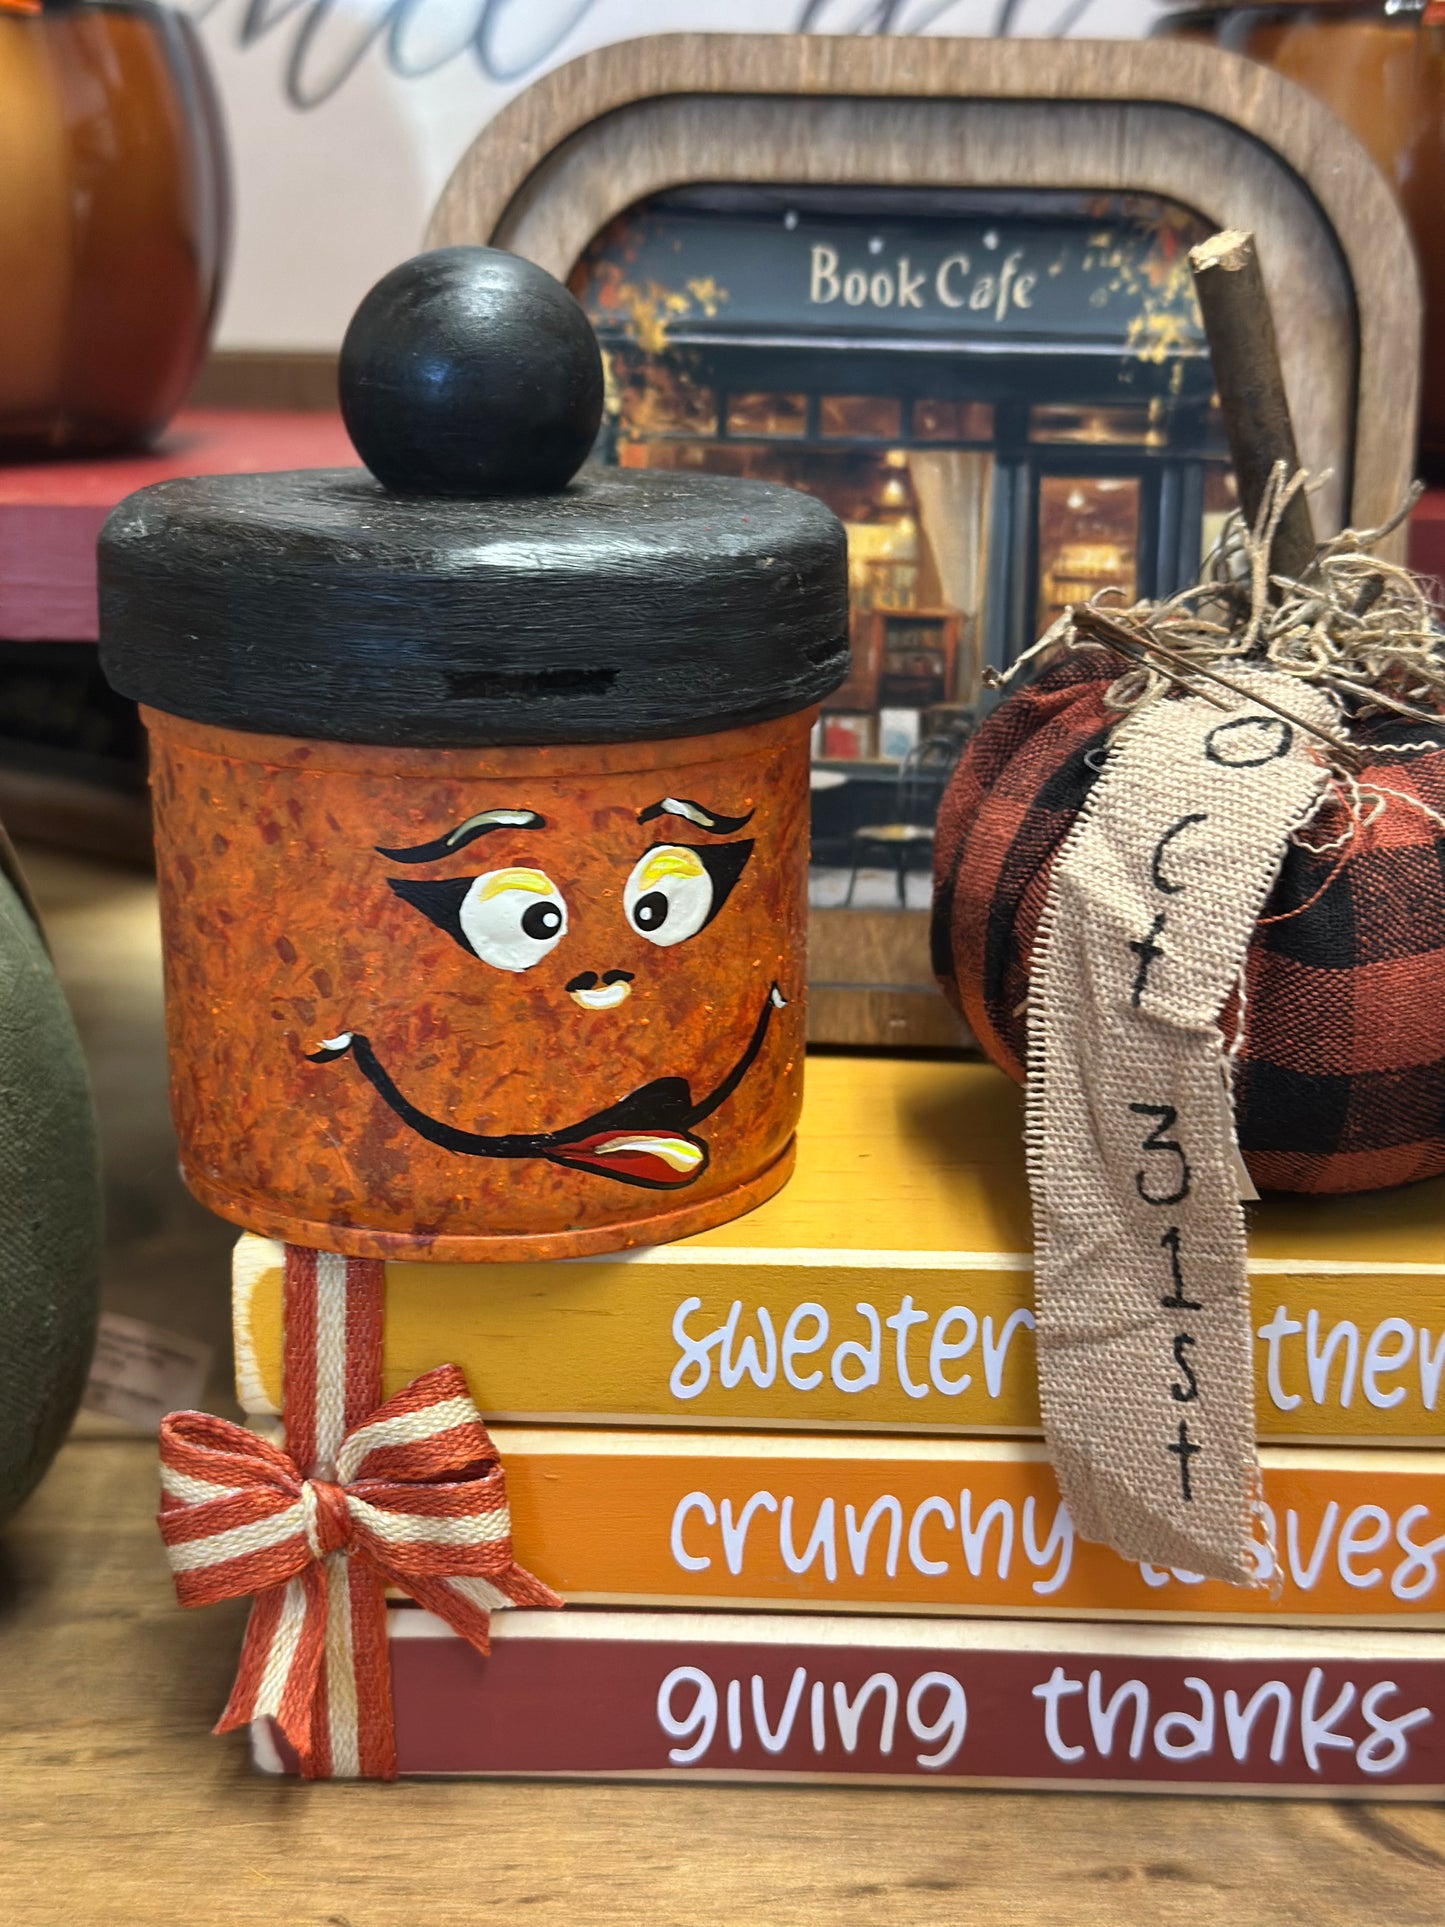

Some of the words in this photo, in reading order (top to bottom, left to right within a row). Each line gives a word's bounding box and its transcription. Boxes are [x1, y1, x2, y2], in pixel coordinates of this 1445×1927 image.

[810, 245, 926, 309] Book
[935, 249, 1037, 322] Cafe
[669, 1294, 1037, 1401] sweater
[1256, 1304, 1445, 1412] ther
[1128, 1102, 1204, 1502] 31st
[669, 1488, 1076, 1596] crunchy
[1139, 1499, 1445, 1600] aves
[656, 1665, 968, 1770] giving
[1030, 1665, 1432, 1775] thanks
